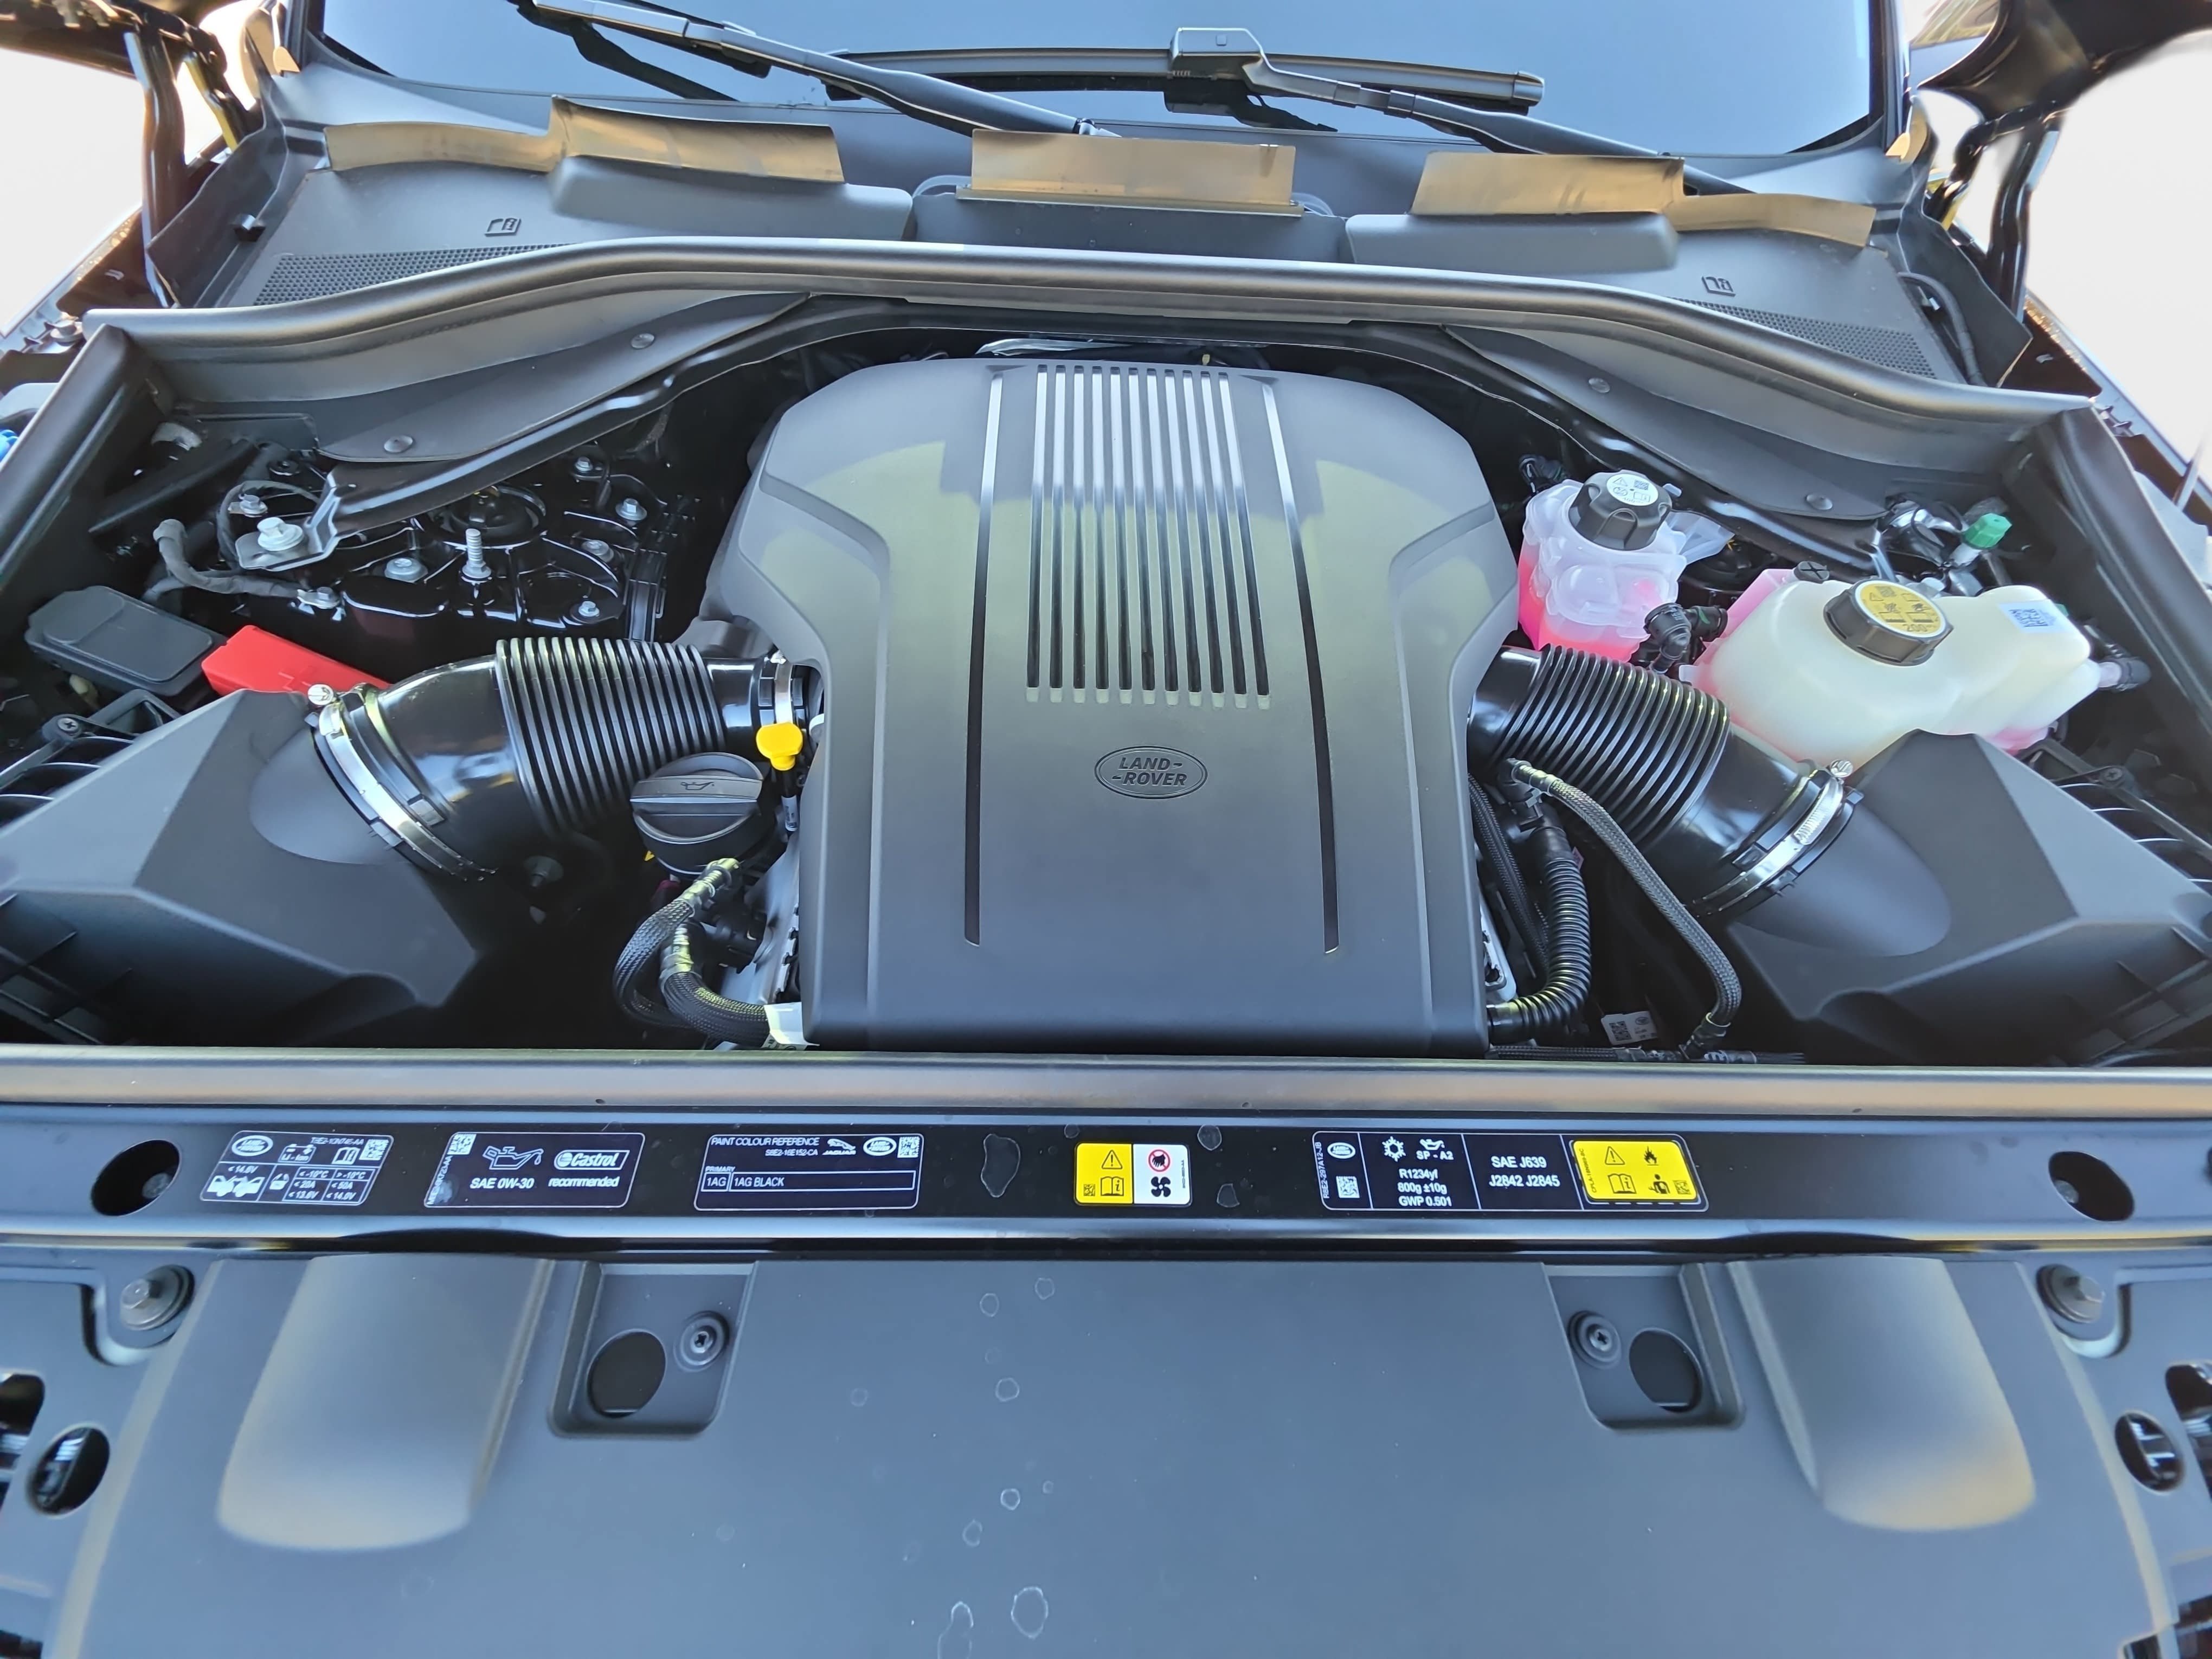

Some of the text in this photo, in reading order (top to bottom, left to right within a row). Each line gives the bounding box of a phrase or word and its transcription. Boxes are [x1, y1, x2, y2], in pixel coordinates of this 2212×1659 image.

[711, 1137, 820, 1146] PAINT COLOUR REFERENCE
[570, 1153, 619, 1167] Castrol
[1491, 1156, 1547, 1168] SAE J639
[1398, 1168, 1438, 1181] R1234yf
[1489, 1174, 1561, 1187] J2842 J2845
[470, 1178, 535, 1189] SAE 0W-30
[548, 1176, 620, 1187] recommended
[706, 1178, 727, 1187] 1AG
[734, 1177, 785, 1187] 1AG BLACK
[1397, 1182, 1423, 1194] 800g
[1398, 1195, 1452, 1207] GWP 0.501
